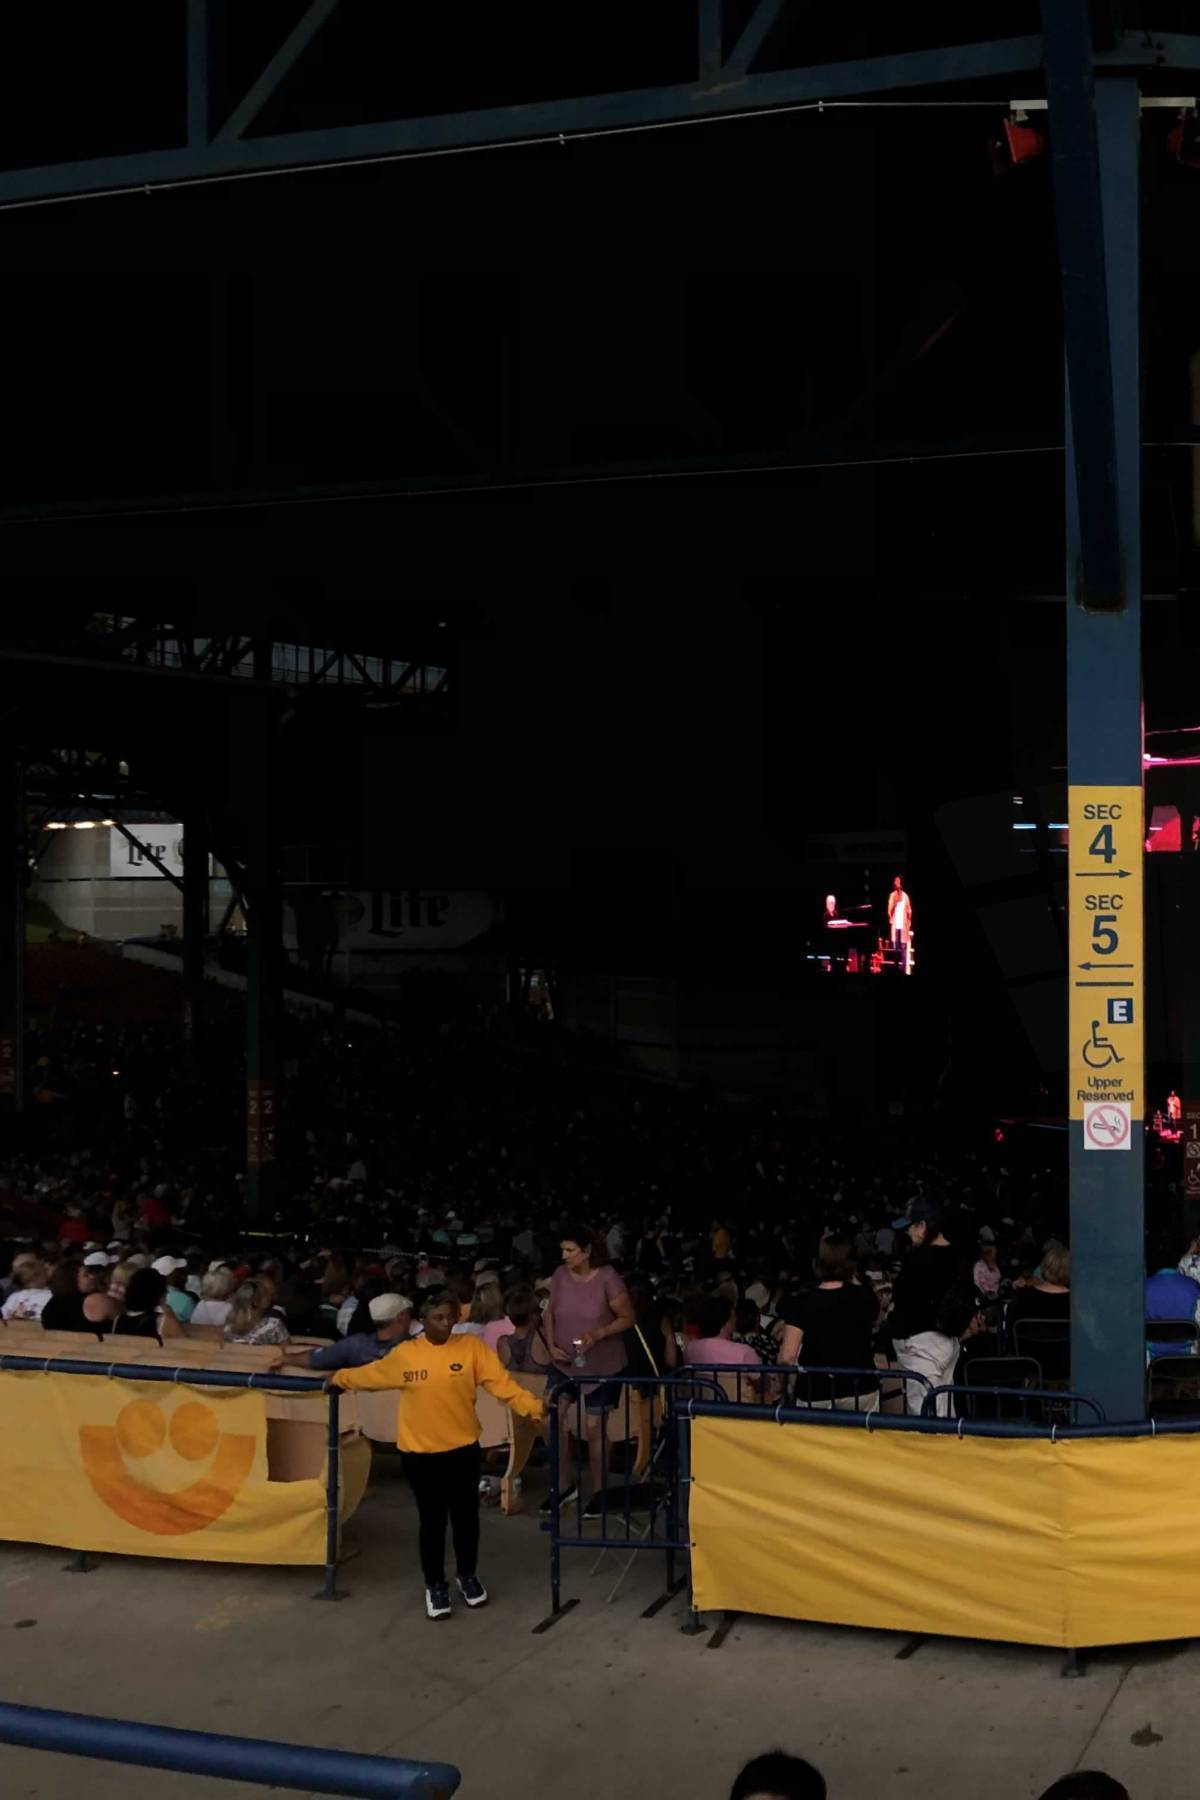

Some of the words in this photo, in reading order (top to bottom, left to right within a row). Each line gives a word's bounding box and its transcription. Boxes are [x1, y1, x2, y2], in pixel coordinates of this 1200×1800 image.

[1083, 804, 1122, 820] SEC
[1089, 824, 1116, 864] 4
[1085, 895, 1123, 911] SEC
[368, 887, 451, 938] Lite
[1091, 915, 1118, 955] 5
[1113, 1001, 1127, 1021] E
[1087, 1076, 1123, 1090] Upper
[1077, 1089, 1134, 1101] Reserved
[263, 1099, 273, 1115] 2
[1189, 1122, 1198, 1140] 1
